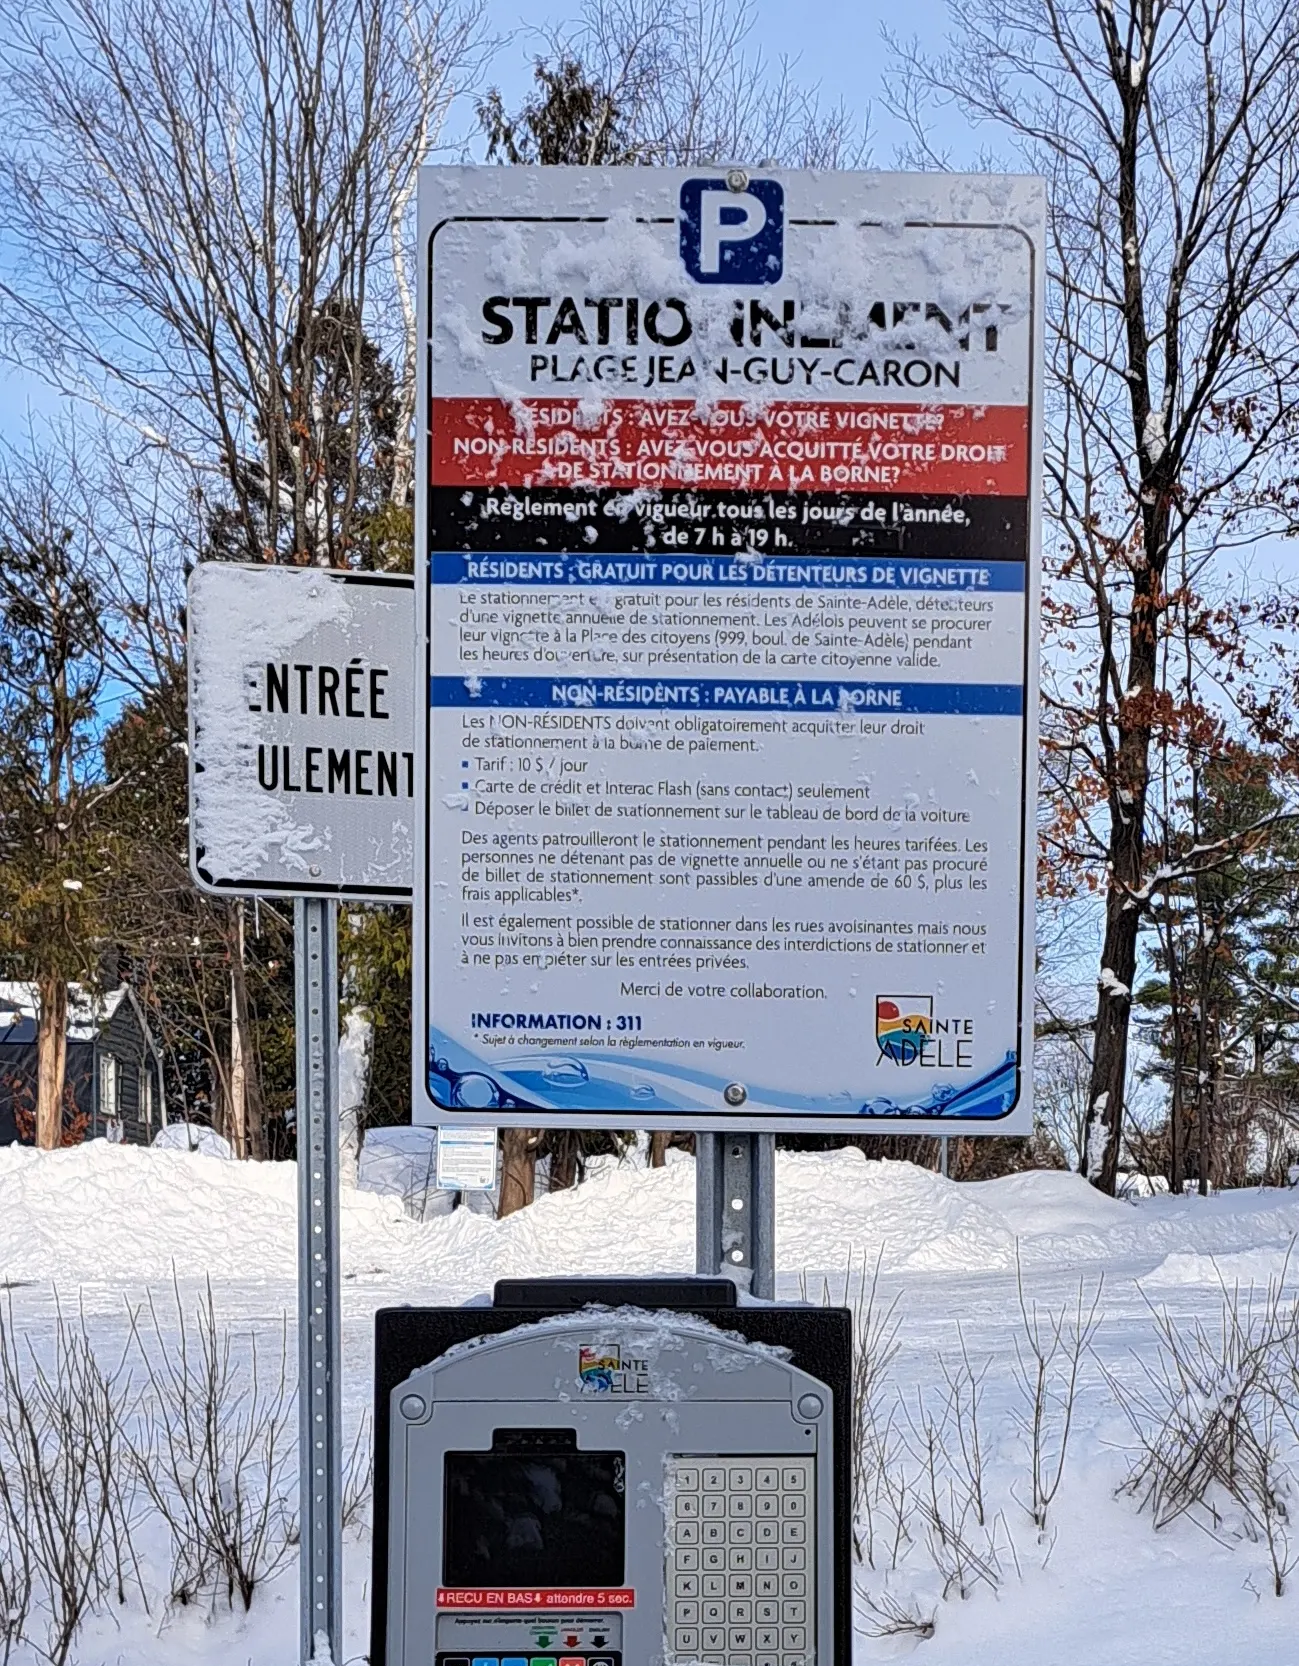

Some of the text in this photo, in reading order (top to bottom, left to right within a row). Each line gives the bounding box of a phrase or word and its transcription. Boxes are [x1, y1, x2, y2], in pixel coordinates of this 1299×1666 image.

[700, 190, 767, 273] P
[530, 354, 637, 383] PLAGE
[764, 411, 830, 428] VOTRE
[760, 437, 863, 462] ACQUITTÉ
[868, 443, 935, 461] VOTRE
[941, 445, 1006, 463] DROIT
[558, 461, 583, 479] DE
[769, 459, 783, 481] À
[789, 465, 815, 482] LA
[820, 466, 900, 483] BORNE?
[769, 501, 797, 519] les
[802, 501, 854, 525] jours
[860, 502, 886, 521] de
[662, 526, 689, 545] de
[694, 528, 708, 545] 7
[712, 526, 724, 545] h
[731, 527, 745, 547] à
[748, 529, 769, 547] 19
[468, 557, 989, 586] RÉSIDENTS GRATUIT POUR LES DÉTENTEURS DE VIGNETTE
[614, 592, 912, 613] gratuit résidents Sainte-Adèle,
[791, 613, 844, 629] Adélois
[849, 617, 907, 633] peuvent
[931, 620, 992, 634] procurer
[650, 630, 972, 653] citoyens Sainte-Adèle) pendant
[482, 647, 940, 670] heures présentation citoyenne valide.
[714, 685, 789, 704] PAYABLE
[793, 683, 807, 704] À
[812, 687, 833, 705] LA
[674, 717, 788, 737] obligatoirement
[484, 734, 762, 756] stationnement paiement.
[475, 756, 588, 776] Tarif 10 jour
[475, 779, 514, 794] Carte
[540, 780, 582, 795] crédit
[605, 781, 653, 796] Interac
[658, 781, 691, 796] Flash
[797, 783, 870, 799] seulement
[475, 801, 970, 823] Déposer stationnement tableau voiture
[492, 832, 961, 854] agents patrouilleront stationnement pendant heures tarifées.
[461, 851, 987, 875] personnes détenant vignette annuelle s'étant procuré
[485, 868, 911, 890] billet stationnement sont passibles amende 60
[473, 914, 986, 935] est également possible stationner dans les rues avoisinantes mais nous
[601, 934, 656, 953] prendre
[660, 935, 752, 950] connaissance
[784, 937, 871, 952] interdictions
[896, 938, 969, 954] stationner
[638, 953, 749, 972] entrées privées.
[620, 981, 827, 999] Merci de votre collaboration.
[471, 1013, 642, 1031] INFORMATION 311
[902, 1019, 973, 1034] SAINTE
[481, 1033, 506, 1046] Sujet
[517, 1034, 577, 1047] changement
[579, 1035, 605, 1046] selon
[607, 1036, 617, 1047] la
[693, 1040, 705, 1048] en
[486, 1593, 504, 1604] EN
[507, 1593, 533, 1604] BAS
[597, 1593, 605, 1604] 5
